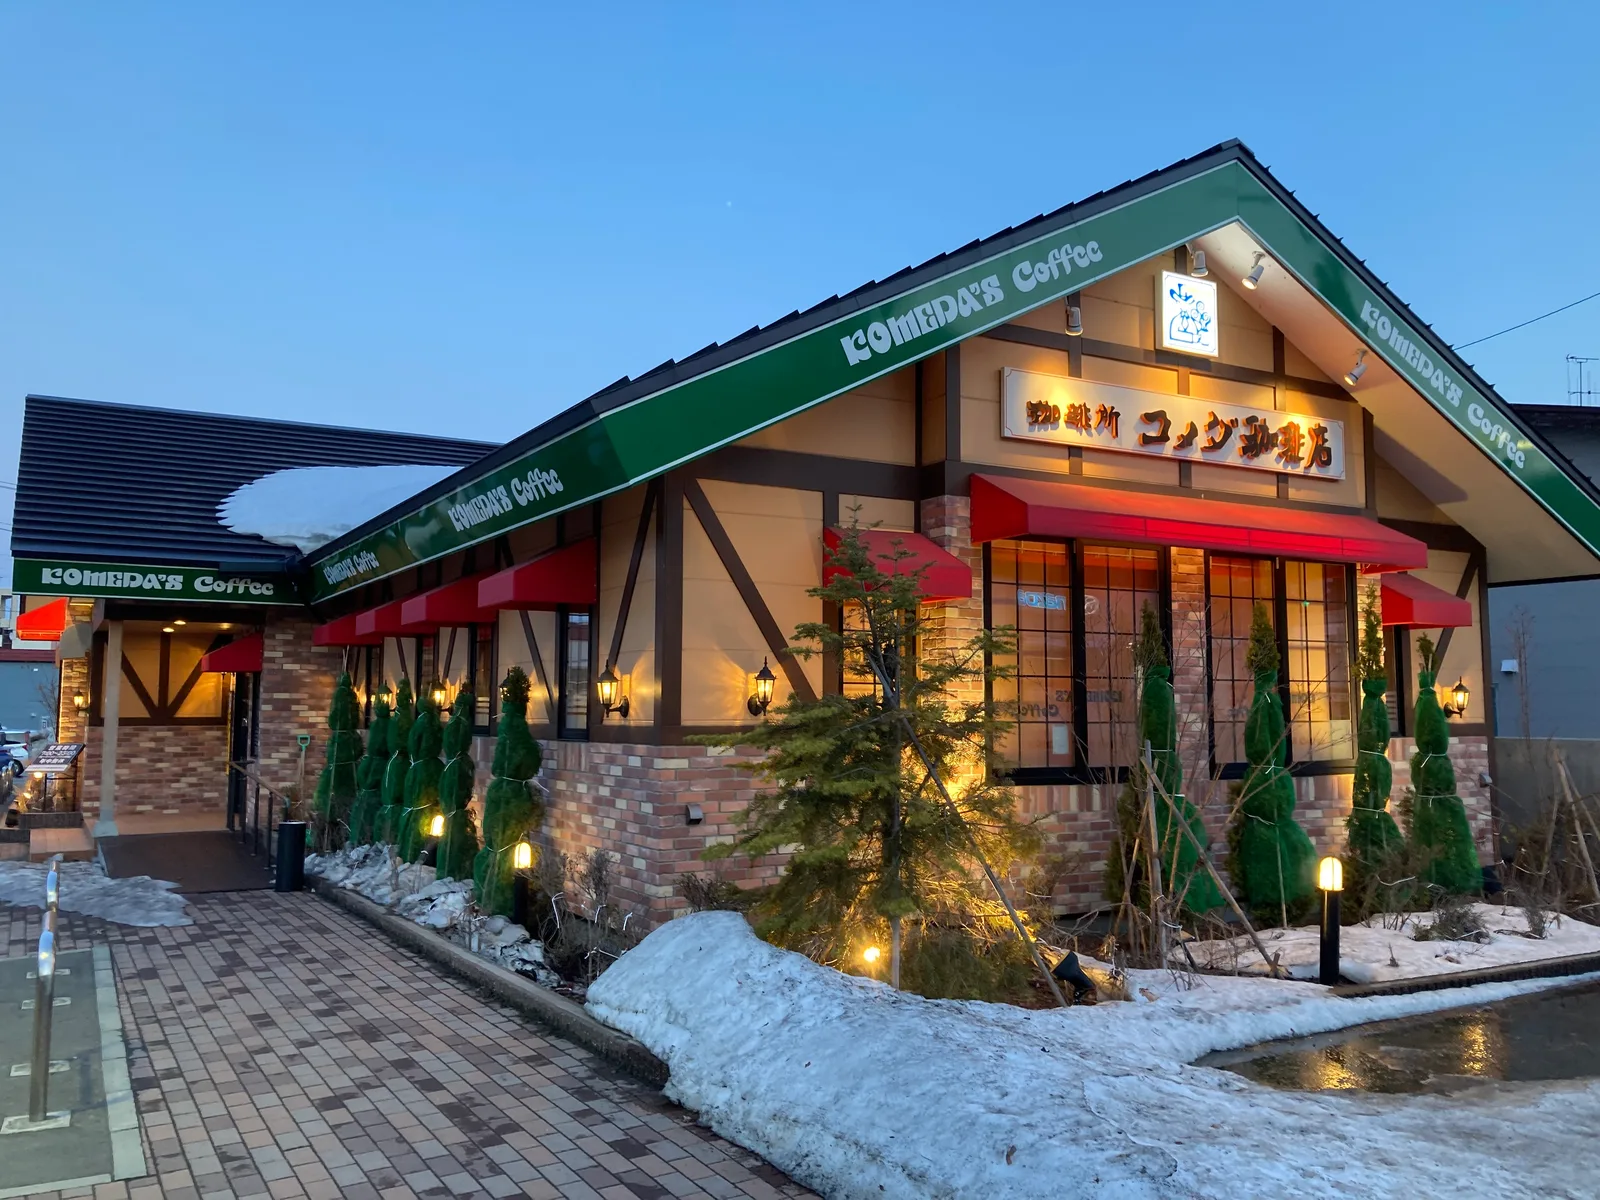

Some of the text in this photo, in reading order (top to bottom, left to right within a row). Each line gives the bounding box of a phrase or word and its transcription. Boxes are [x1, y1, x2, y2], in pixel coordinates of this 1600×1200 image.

[840, 240, 1103, 366] KOMEDA'S Coffee
[1360, 300, 1526, 468] KOMEDA'S Coffee
[1138, 409, 1332, 469] コメダ珈琲店
[447, 467, 564, 532] KOMEDA'S Coffee
[41, 568, 274, 596] KOMEDA'S Coffee
